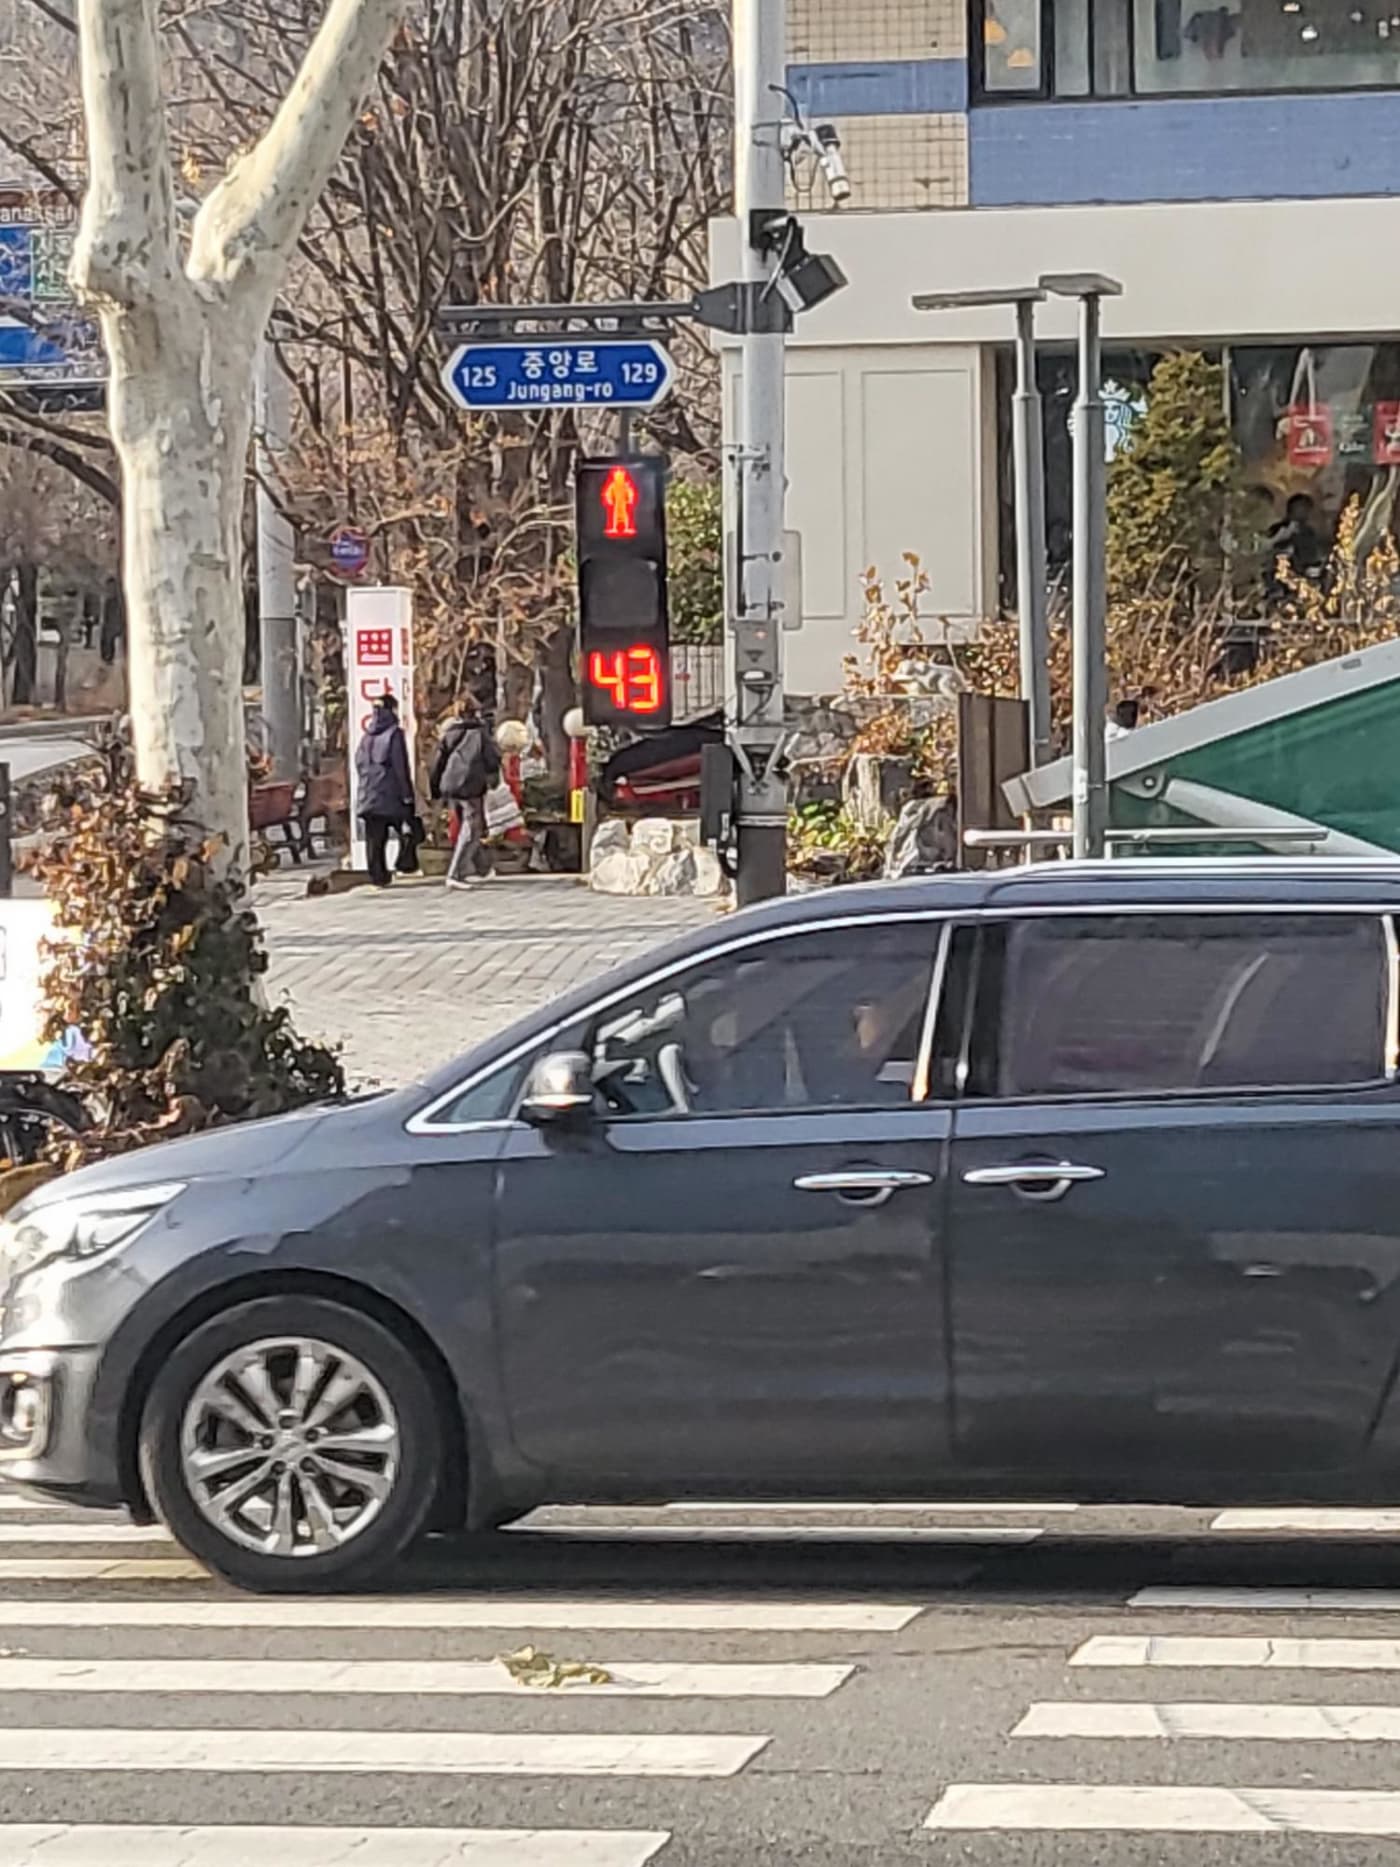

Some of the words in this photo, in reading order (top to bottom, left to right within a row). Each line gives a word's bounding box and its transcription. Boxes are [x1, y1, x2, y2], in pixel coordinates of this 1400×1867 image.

[521, 350, 599, 379] 중앙로
[622, 363, 658, 384] 129
[461, 366, 497, 388] 125
[507, 381, 614, 402] Jungang-ro
[590, 647, 660, 712] 43
